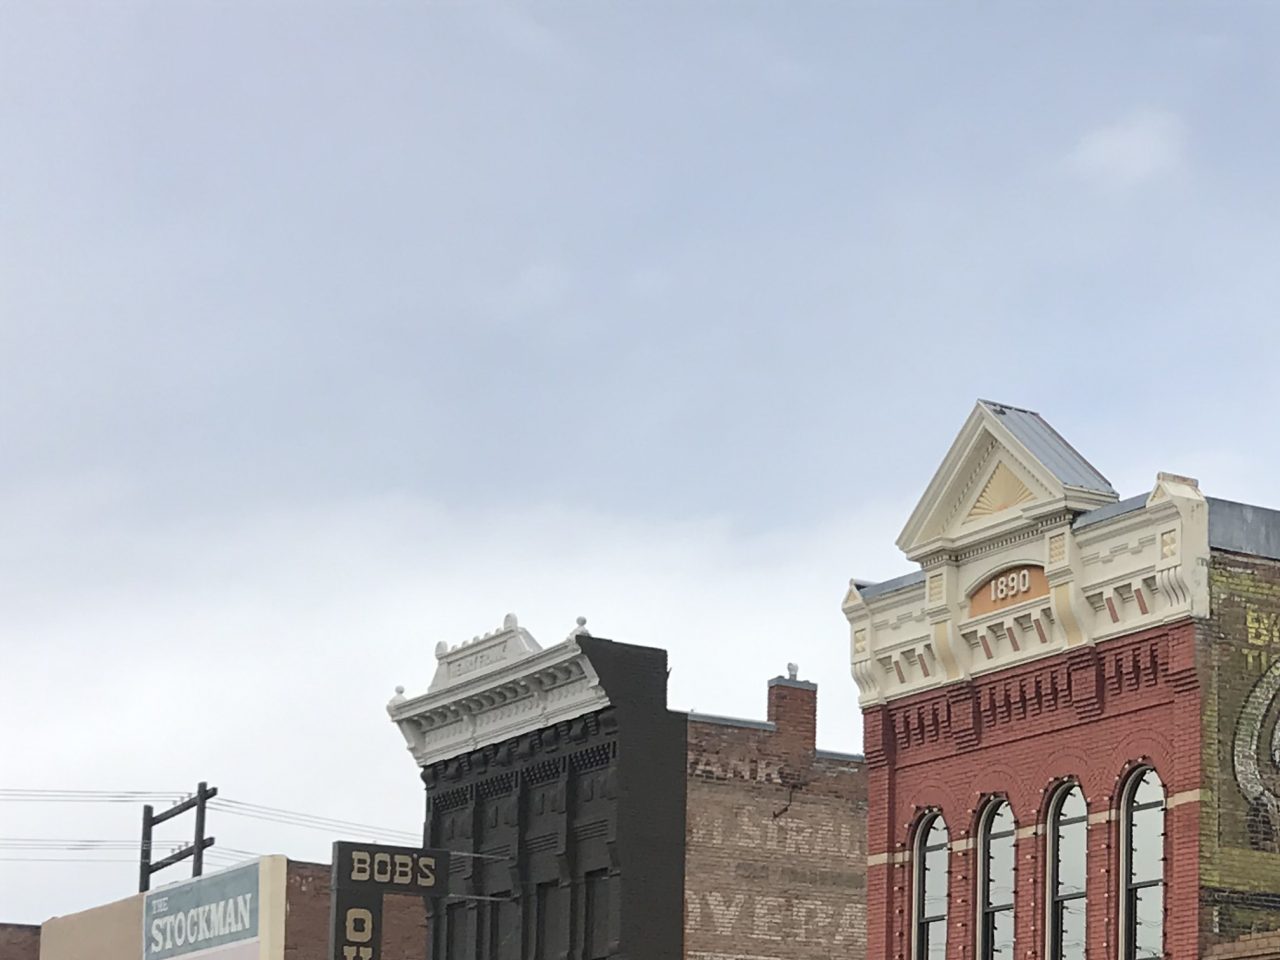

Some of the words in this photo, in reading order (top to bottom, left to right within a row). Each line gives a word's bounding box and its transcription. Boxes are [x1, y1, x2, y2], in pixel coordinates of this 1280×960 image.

[991, 569, 1030, 601] 1890
[351, 851, 435, 886] BOB'S
[152, 897, 168, 914] THE
[151, 893, 252, 953] STOCKMAN
